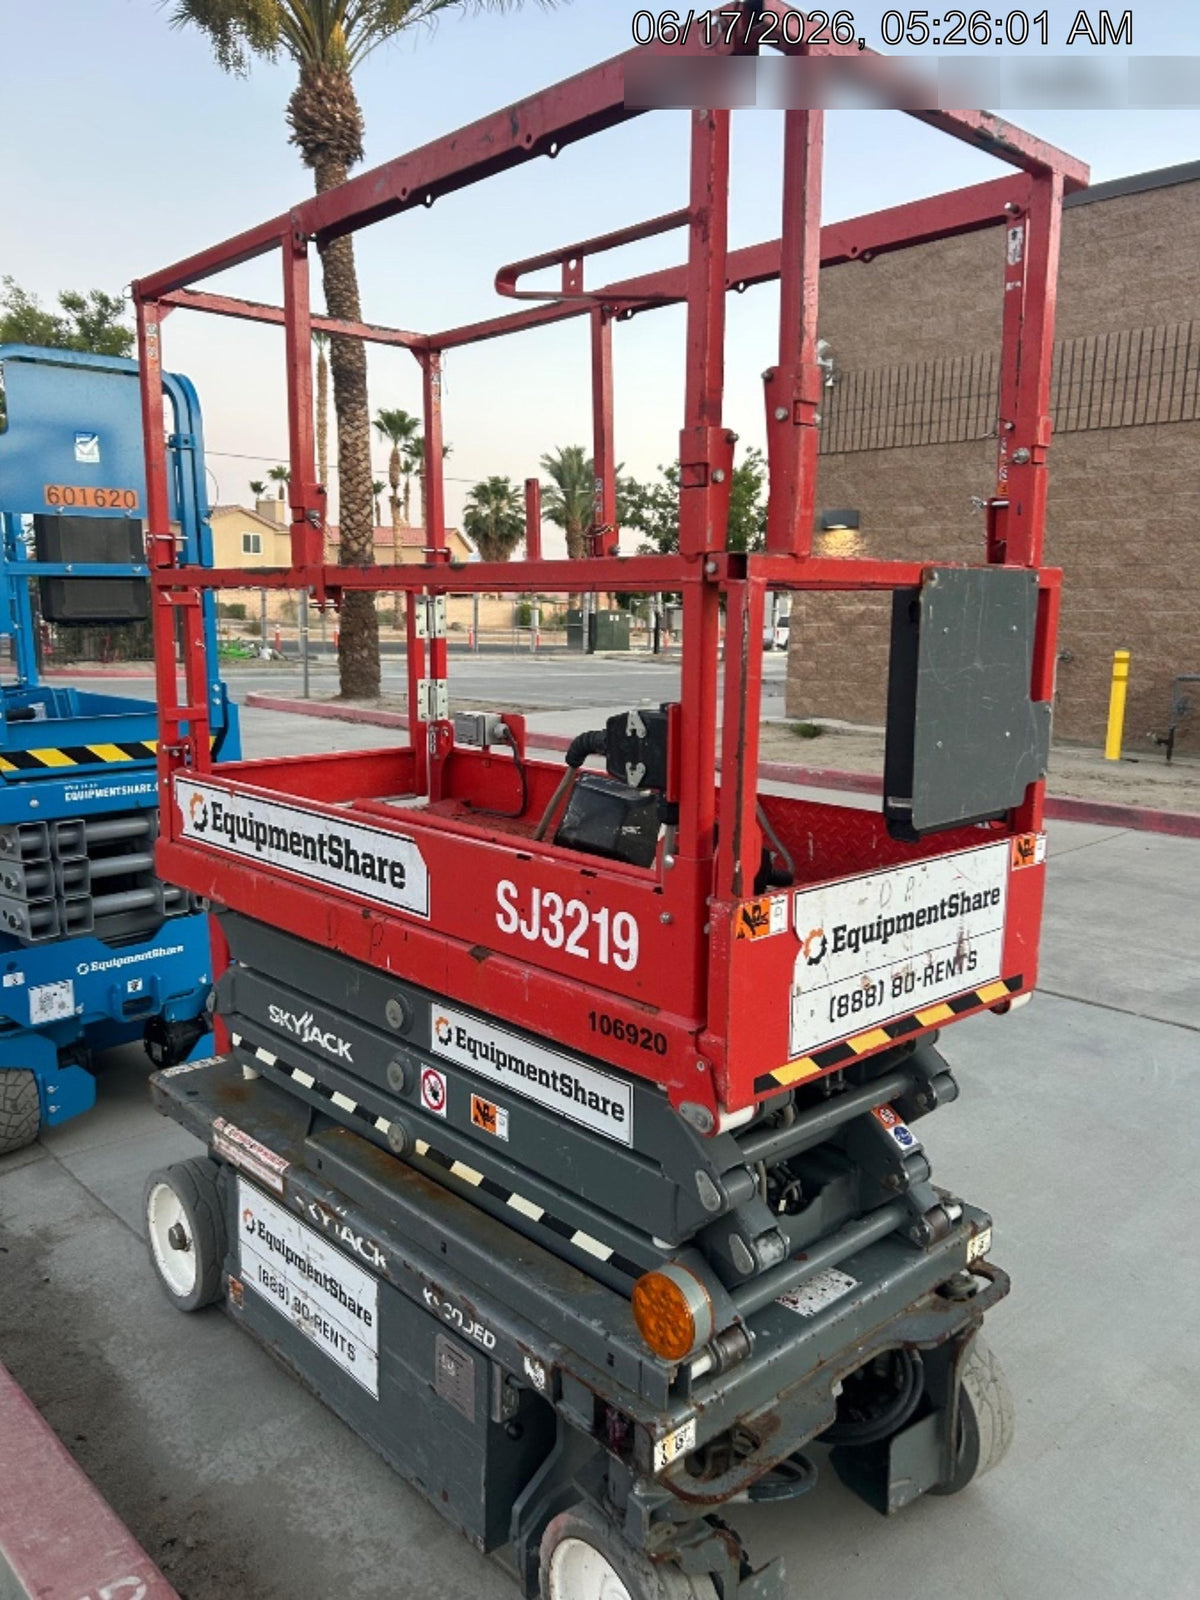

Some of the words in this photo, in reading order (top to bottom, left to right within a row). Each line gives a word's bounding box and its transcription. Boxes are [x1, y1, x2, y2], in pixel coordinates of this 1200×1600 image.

[46, 486, 136, 509] 601620
[211, 801, 406, 890] EquipmentShare
[495, 880, 639, 972] SJ3219
[831, 887, 1001, 955] EquipmentShare
[90, 945, 184, 971] EquipmentShare
[829, 980, 885, 1023] (888)
[268, 1004, 354, 1064] SKYJACK
[588, 1011, 668, 1056] 106920
[455, 1026, 625, 1123] EquipmentShare
[257, 1219, 373, 1328] EquipmentShare
[258, 1265, 290, 1306] (888)
